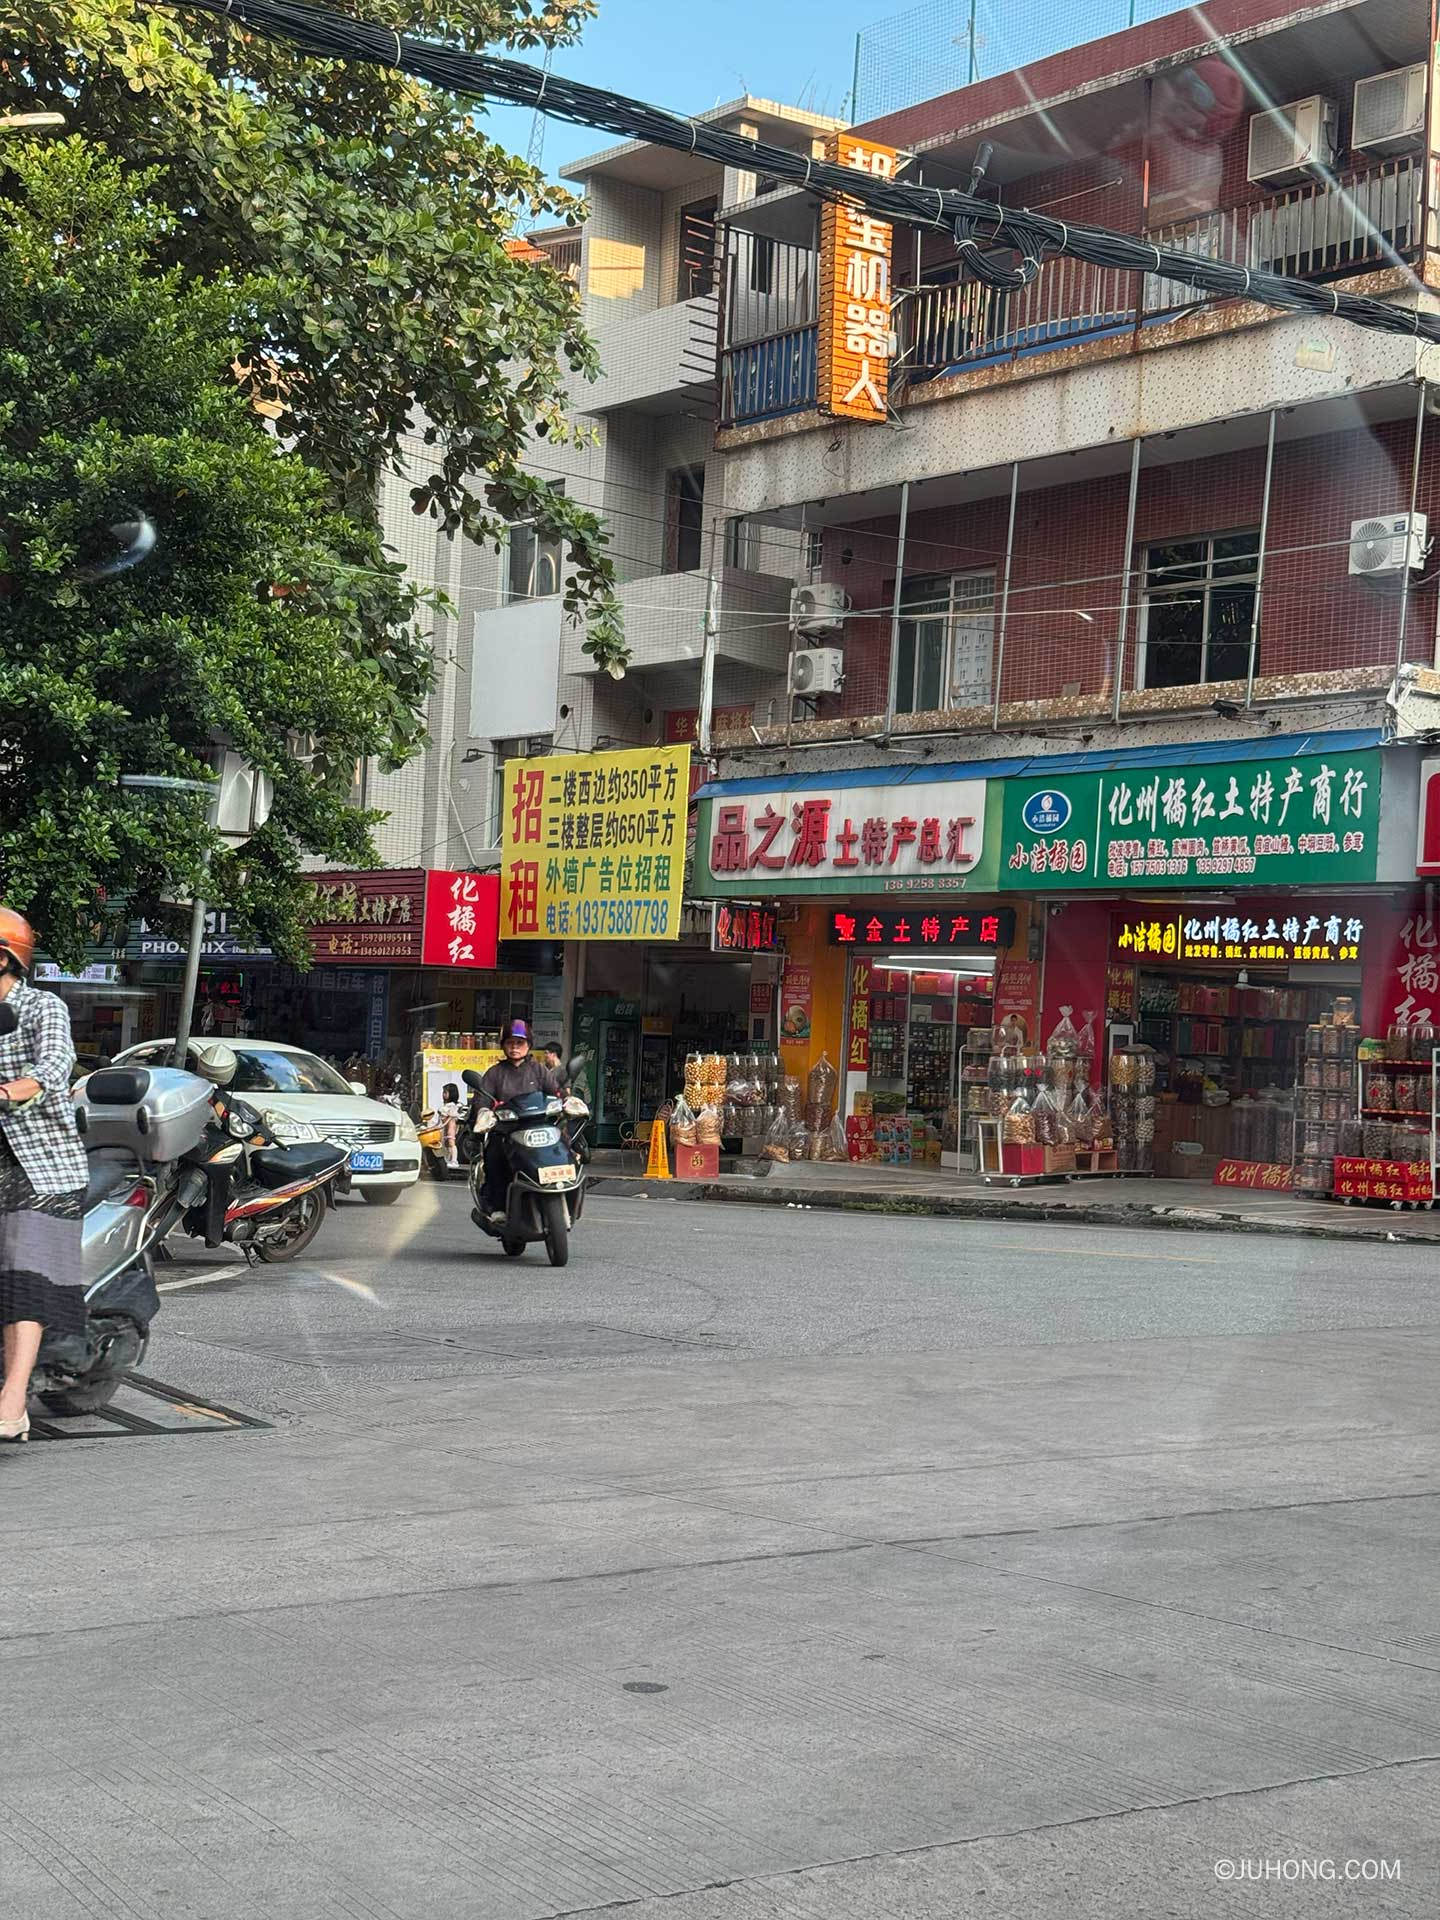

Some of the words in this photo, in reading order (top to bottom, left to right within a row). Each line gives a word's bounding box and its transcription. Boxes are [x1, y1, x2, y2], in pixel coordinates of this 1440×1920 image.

[549, 762, 678, 808] 二楼西边约350平方
[1108, 764, 1368, 832] 化州橘红土特产商行
[508, 768, 544, 935] 招租
[547, 808, 676, 851] 三楼整层约650平方
[546, 853, 671, 895] 外墙广告位招租
[447, 876, 480, 964] 化橘红
[1184, 915, 1364, 945] 化州橘红土特产商行
[852, 965, 869, 1064] 化橘红
